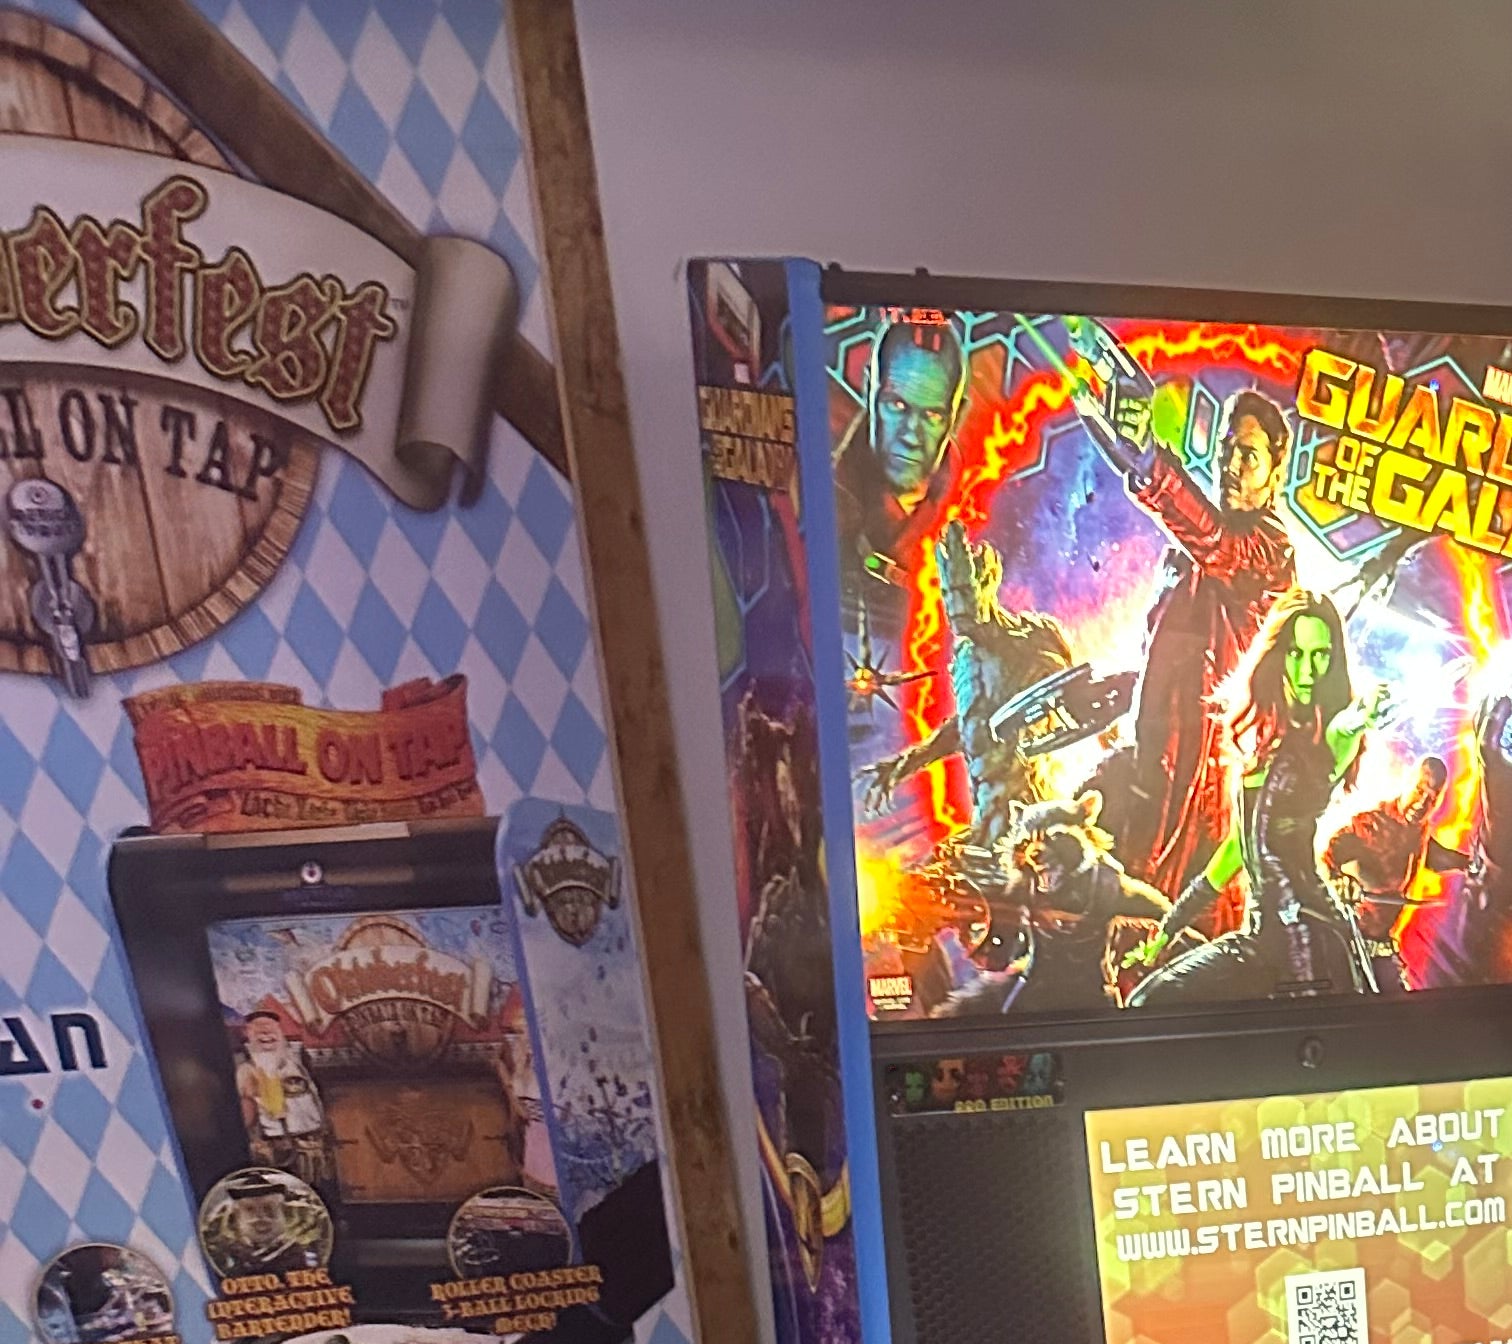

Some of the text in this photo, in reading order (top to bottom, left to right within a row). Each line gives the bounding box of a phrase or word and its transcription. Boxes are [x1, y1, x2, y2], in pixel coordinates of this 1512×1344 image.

[58, 388, 290, 502] ON TAP
[1335, 437, 1382, 473] OF
[1314, 462, 1371, 512] THE
[314, 731, 383, 785] ON
[869, 976, 912, 997] MARVEL
[991, 1095, 1055, 1111] EDITION
[1100, 1109, 1505, 1174] LEARN MORE ABOUT
[1113, 1154, 1500, 1220] STERN PINBALL AT
[286, 1267, 331, 1287] THE
[430, 1265, 604, 1301] ROLLER COASTER
[209, 1286, 355, 1320] INTERACTIVE
[513, 1286, 600, 1308] LOCKING
[217, 1309, 350, 1339] BARTENDER!
